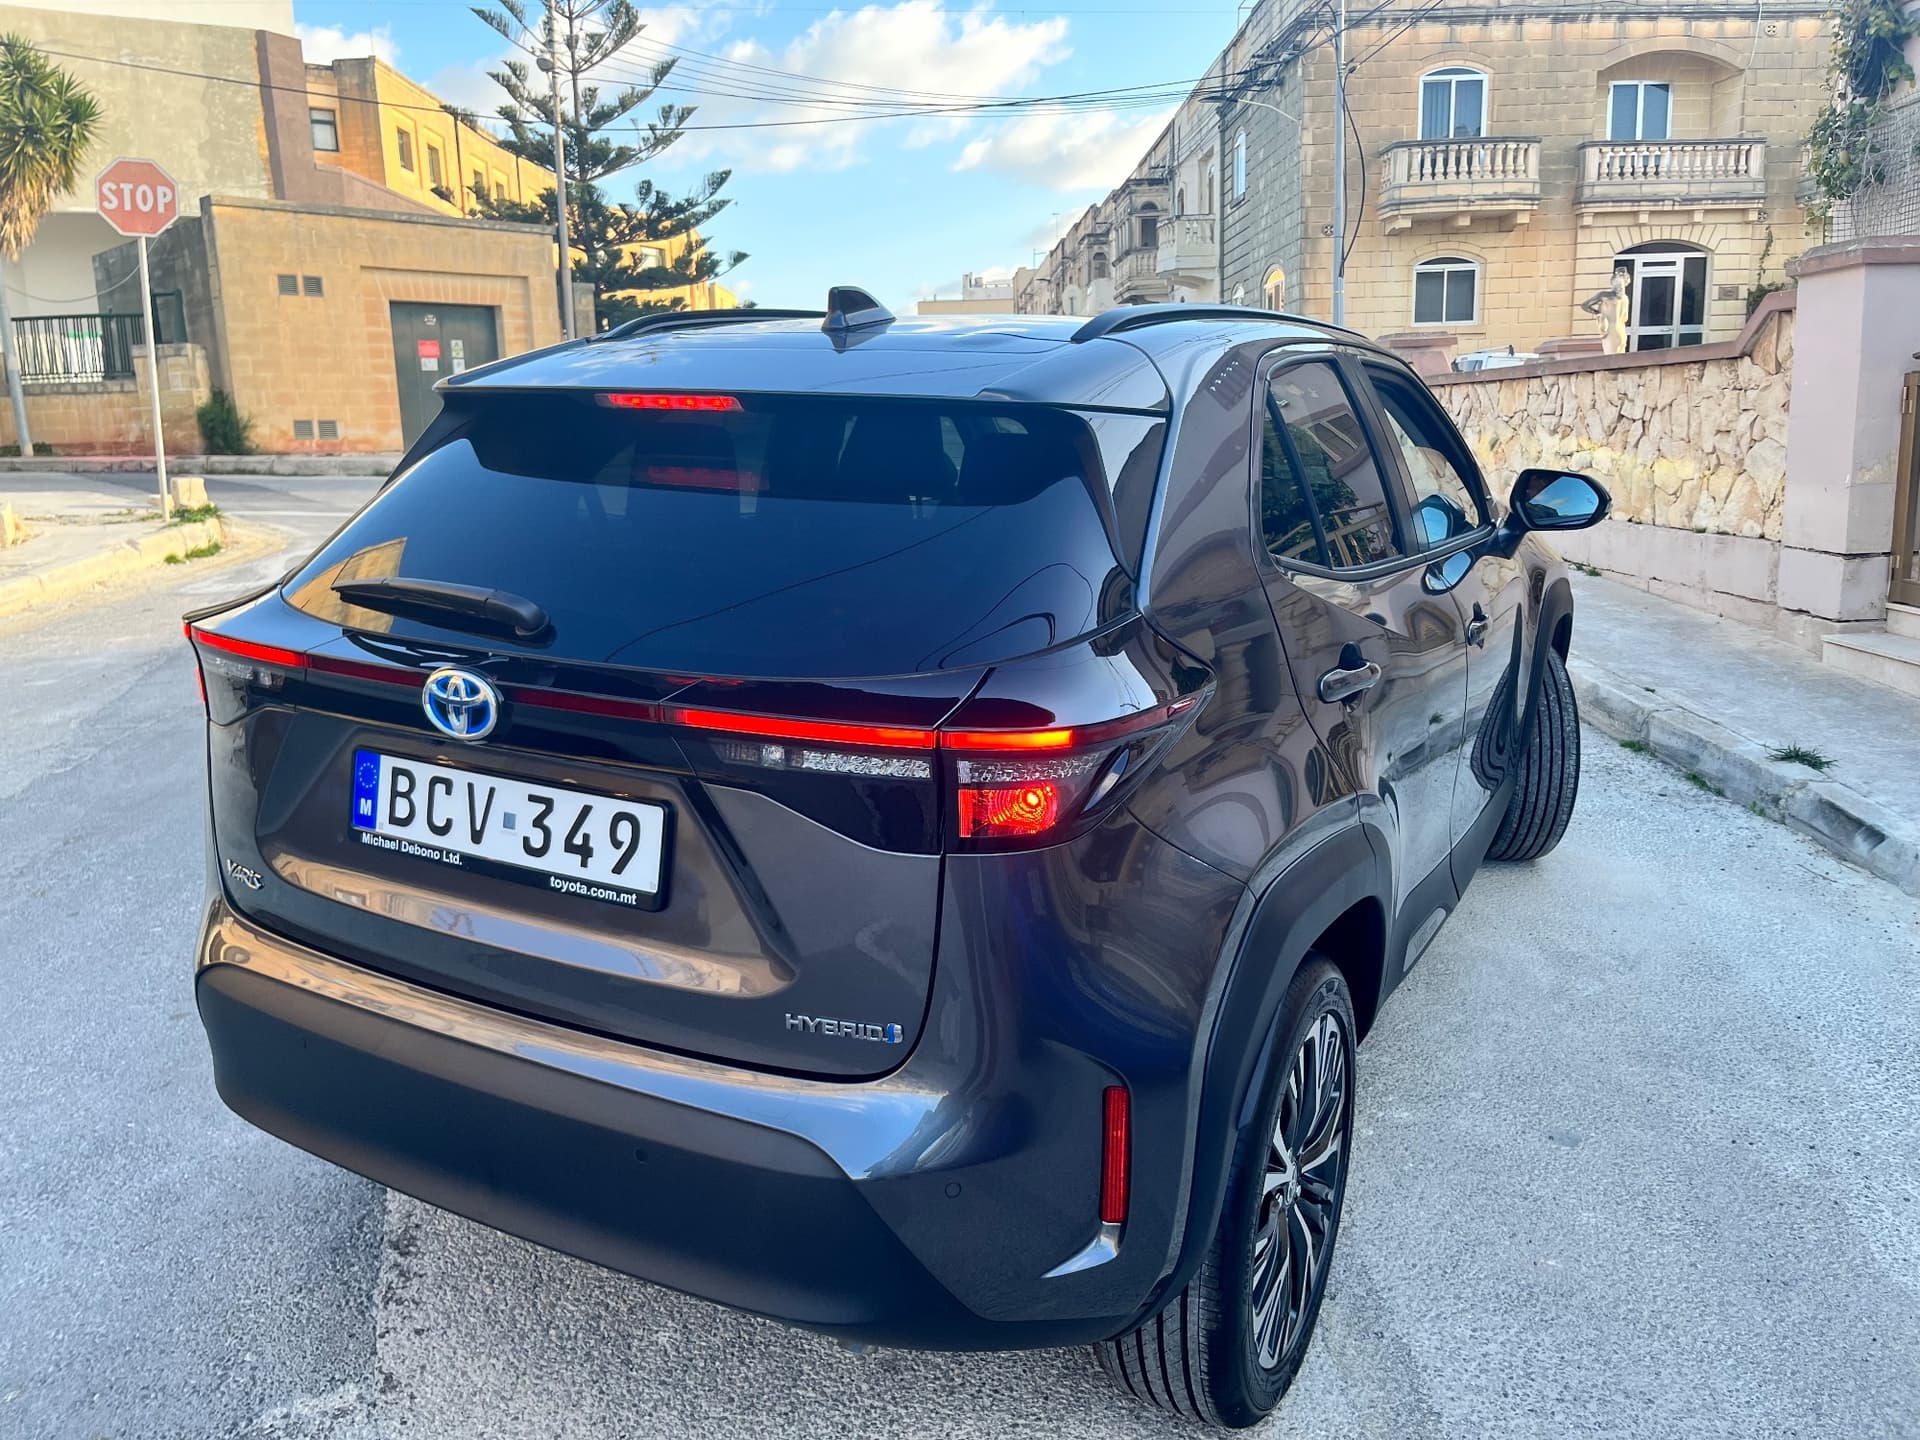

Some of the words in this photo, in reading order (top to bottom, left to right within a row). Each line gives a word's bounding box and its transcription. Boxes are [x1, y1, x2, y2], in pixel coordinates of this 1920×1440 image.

[102, 181, 173, 214] STOP
[360, 798, 372, 816] M
[388, 766, 496, 844] BCV
[522, 794, 641, 875] 349
[361, 832, 399, 851] Michael
[401, 841, 441, 860] Debono
[443, 850, 463, 866] Ltd.
[550, 876, 637, 905] toyota.com.mt
[785, 1013, 883, 1042] HYBRID
